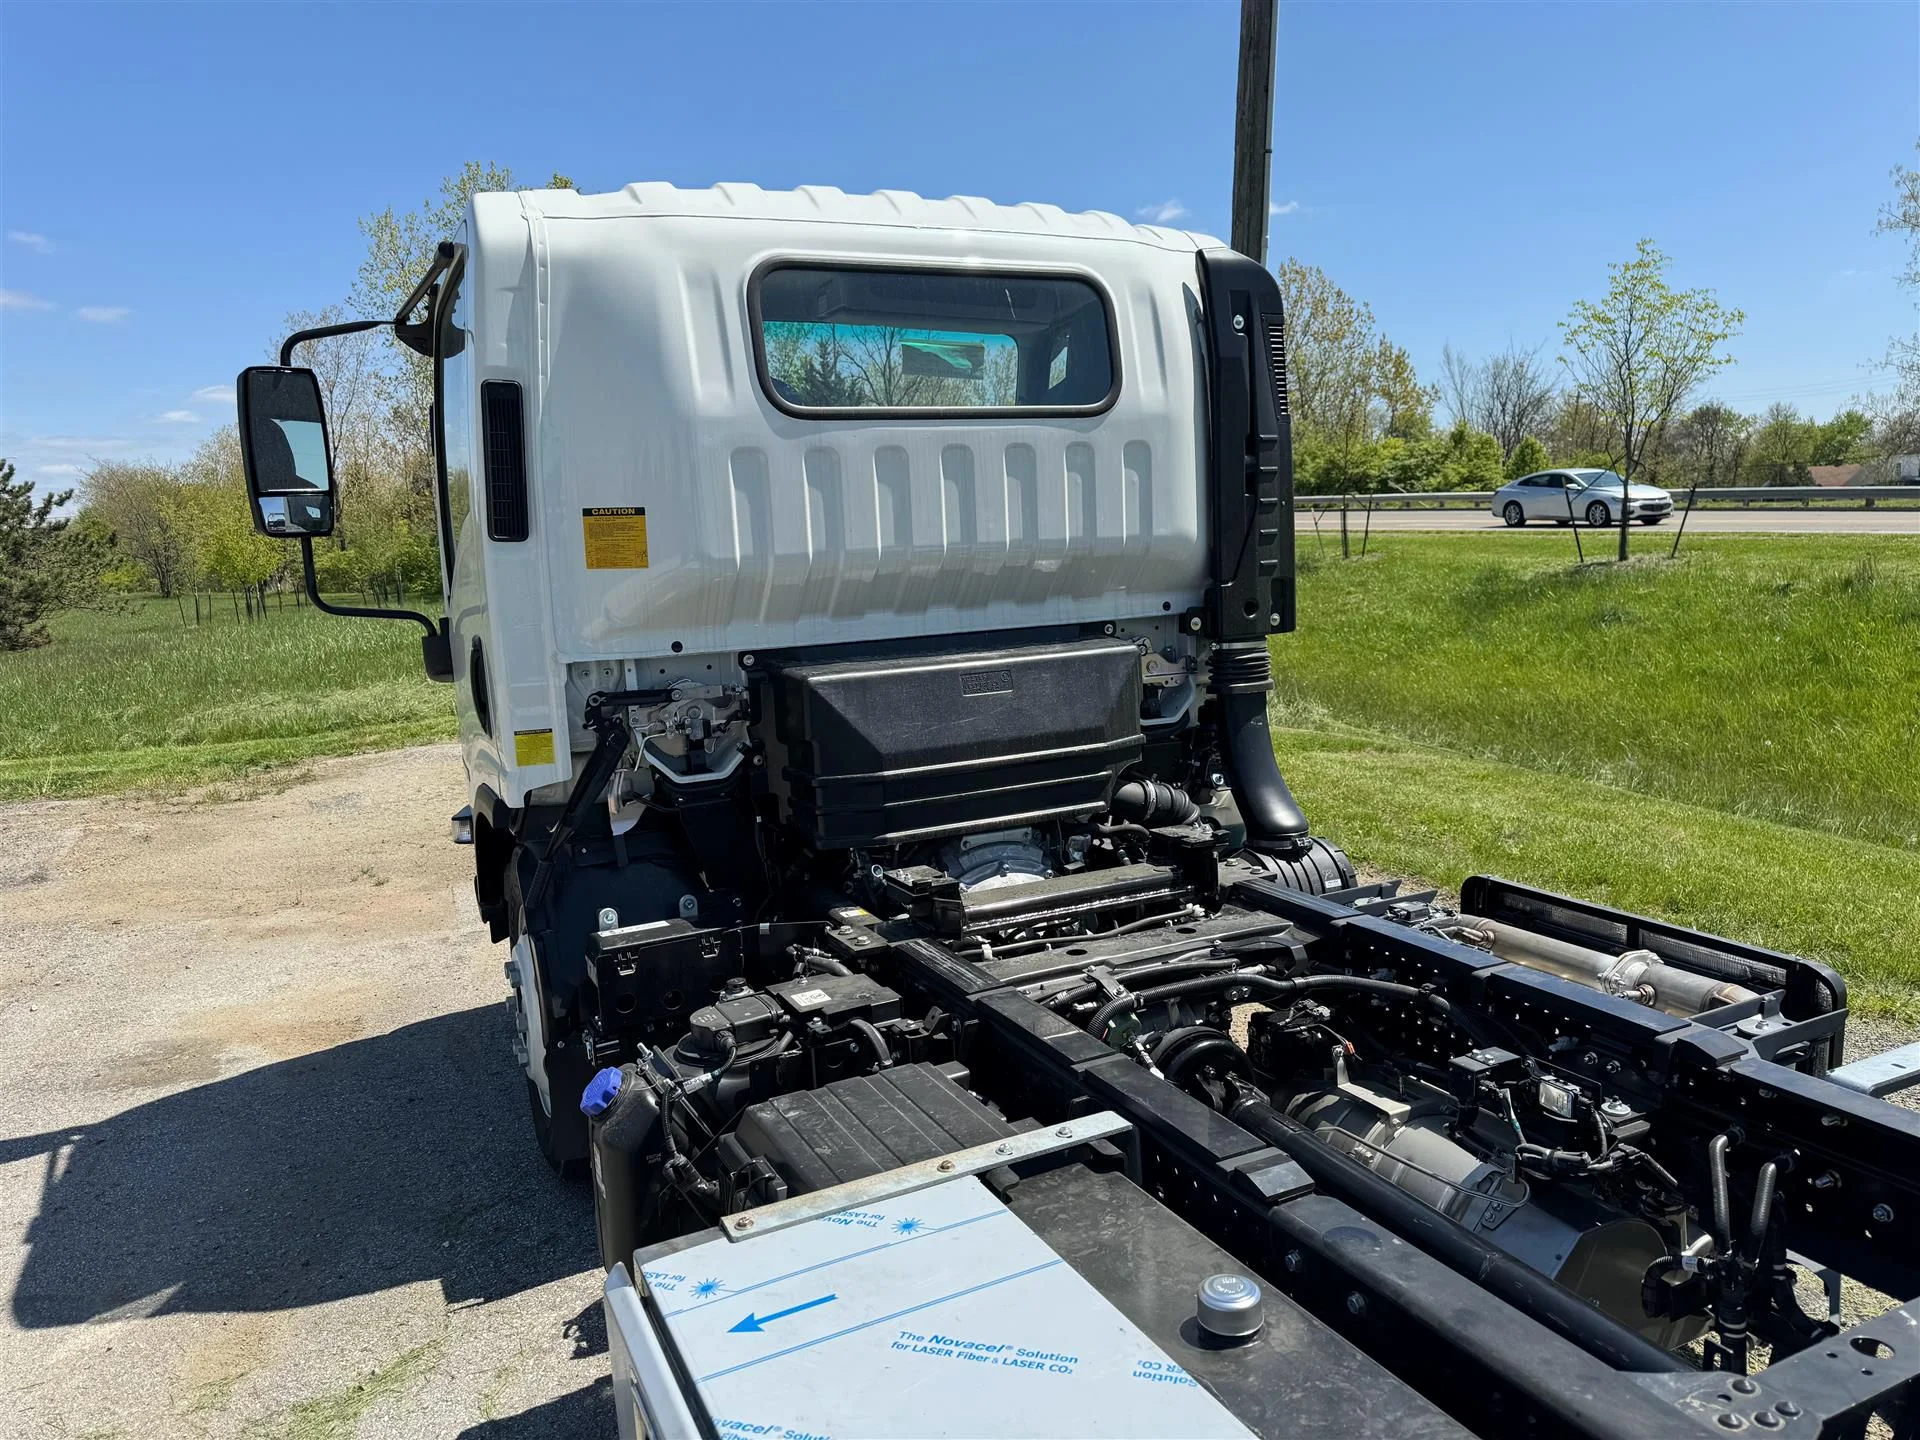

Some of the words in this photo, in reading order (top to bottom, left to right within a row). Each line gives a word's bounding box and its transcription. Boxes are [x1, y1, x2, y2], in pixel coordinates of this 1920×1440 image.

[654, 1282, 676, 1291] The
[669, 1274, 686, 1282] for
[890, 1341, 911, 1350] for
[912, 1344, 954, 1358] LASER
[956, 1351, 990, 1364] Fiber
[1002, 1358, 1045, 1370] LASER
[898, 1330, 925, 1342] The
[1016, 1348, 1078, 1364] Solution
[1132, 1370, 1198, 1388] Solution
